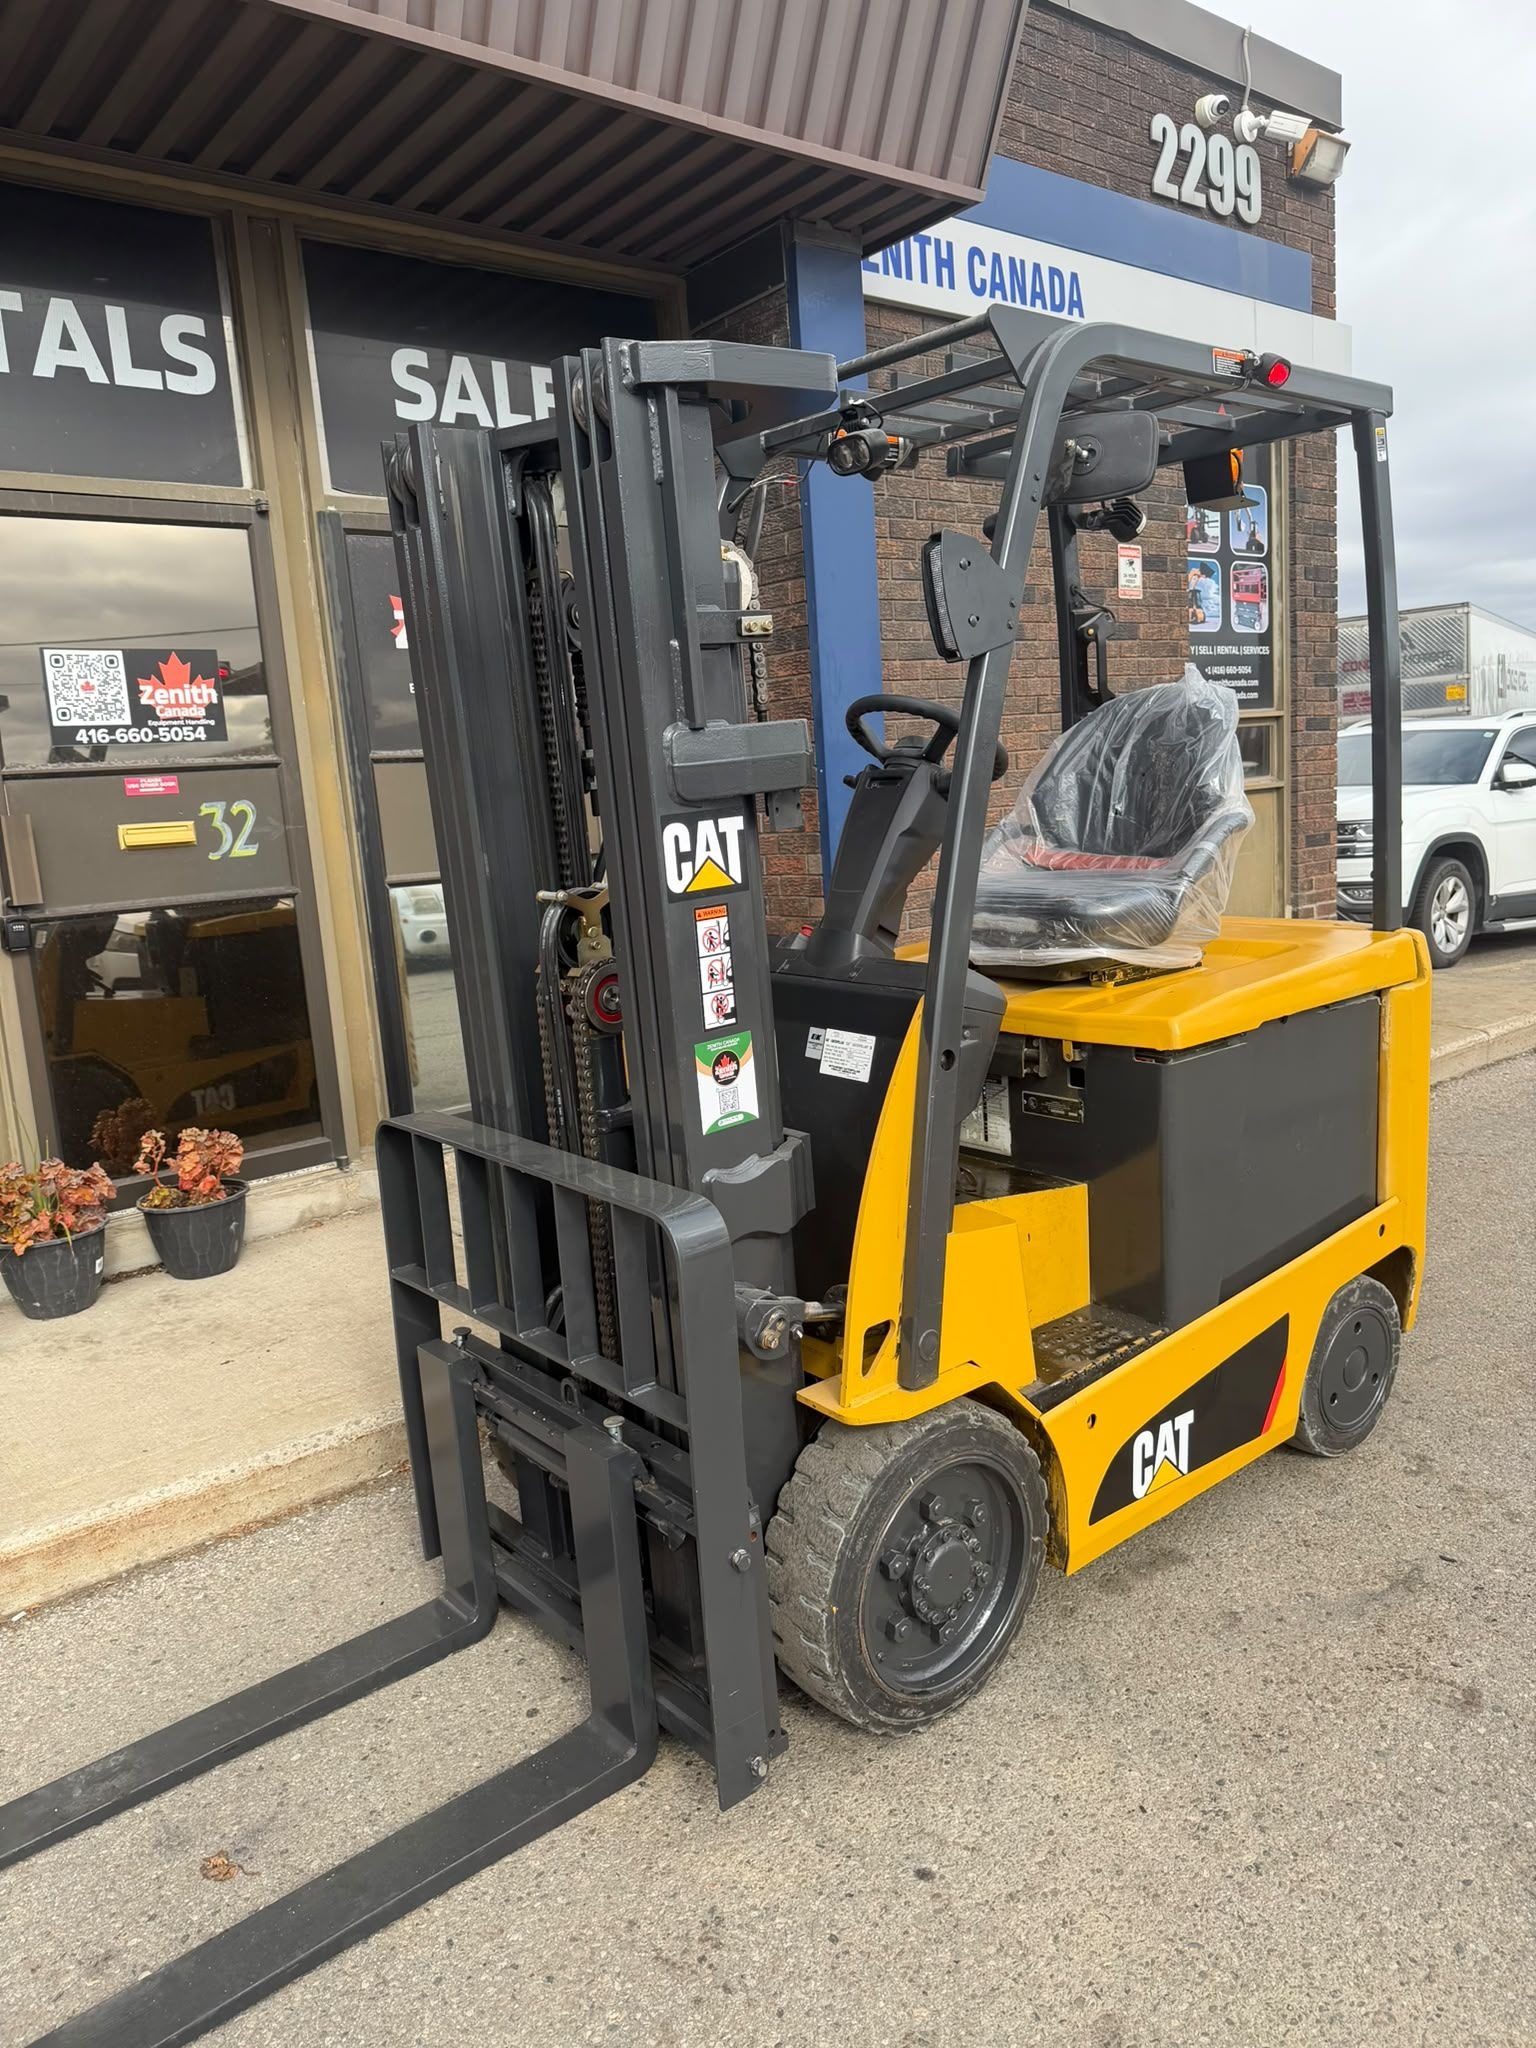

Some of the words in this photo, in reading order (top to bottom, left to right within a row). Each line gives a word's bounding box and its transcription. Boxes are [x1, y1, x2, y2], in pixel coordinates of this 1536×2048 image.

[1150, 113, 1262, 224] 2299
[967, 246, 1085, 318] CANADA
[1199, 645, 1213, 655] SELL
[1217, 645, 1239, 655] RENTAL
[1243, 645, 1270, 655] SERVICES
[139, 683, 219, 705] Zenith
[155, 705, 206, 717] Canada
[75, 726, 207, 744] 416-660-5054
[147, 719, 185, 727] Equipment
[185, 718, 216, 727] Handling
[198, 799, 259, 861] 32
[662, 815, 745, 894] CAT
[1131, 1409, 1195, 1499] CAT
